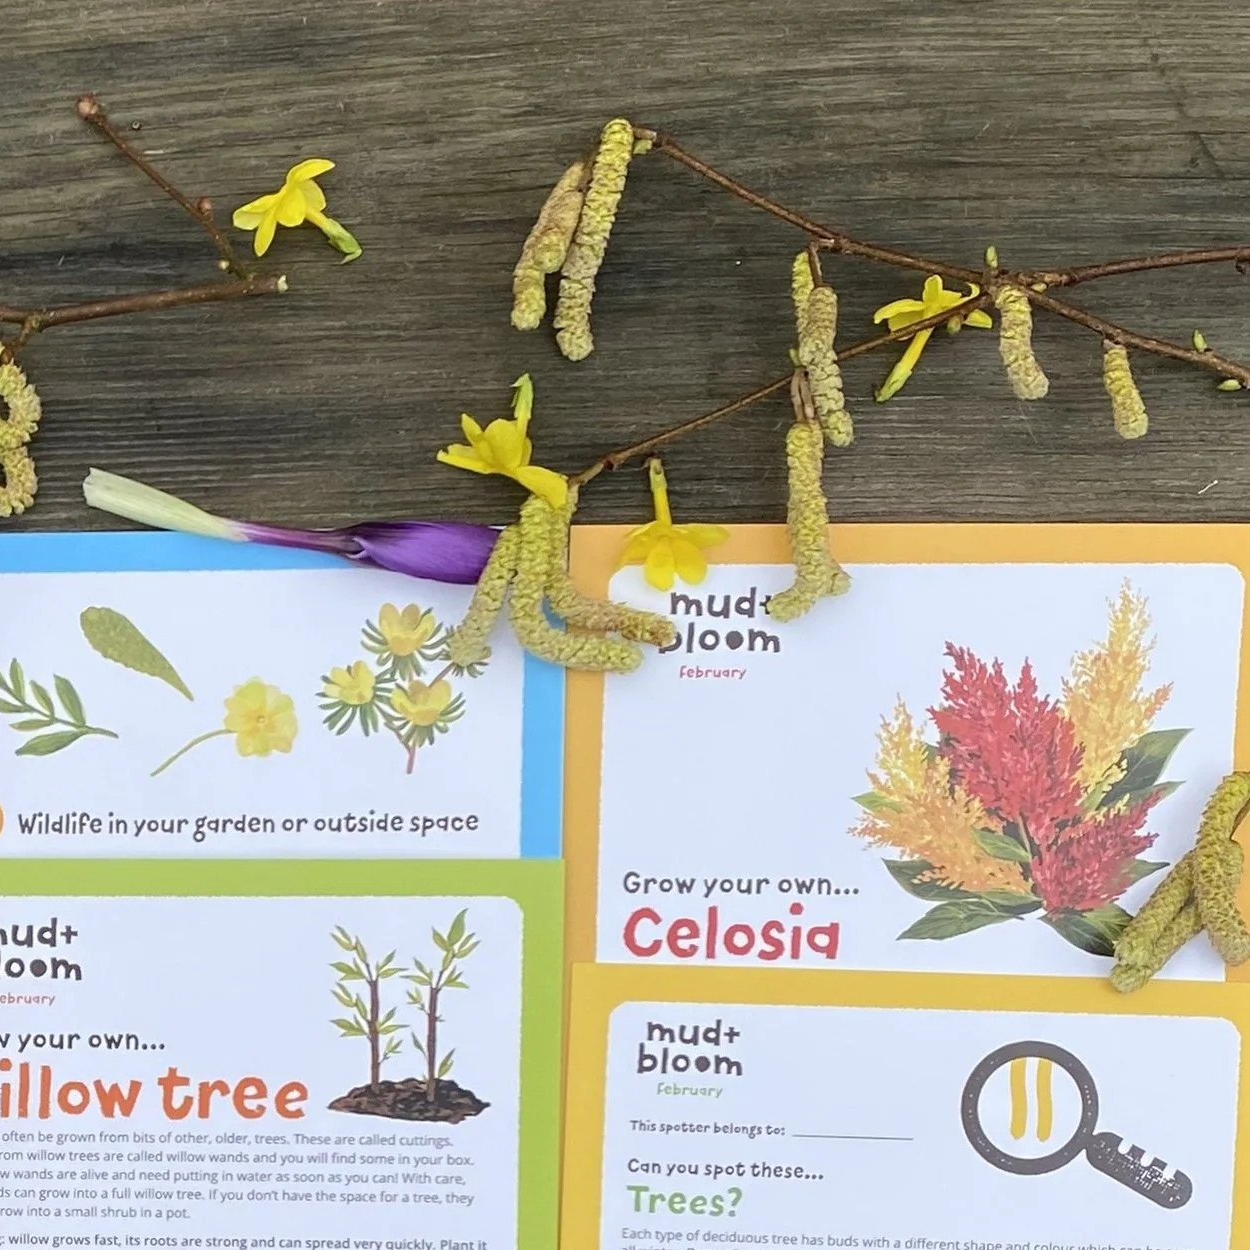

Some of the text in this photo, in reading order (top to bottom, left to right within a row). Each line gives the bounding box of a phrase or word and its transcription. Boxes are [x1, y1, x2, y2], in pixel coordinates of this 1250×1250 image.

[18, 809, 478, 842] Wildlife in your garden or outside space
[623, 871, 858, 903] Grow your own...
[622, 903, 839, 967] Celosia
[18, 1033, 80, 1052] your
[88, 1033, 164, 1050] own...
[647, 1019, 740, 1048] mud+
[637, 1043, 742, 1076] bloom
[157, 1066, 308, 1120] tree
[2, 1130, 34, 1142] often
[38, 1131, 53, 1142] be
[56, 1133, 95, 1145] grown
[99, 1131, 128, 1142] from
[133, 1132, 155, 1143] bits
[158, 1131, 172, 1143] of
[174, 1132, 211, 1144] other,
[215, 1132, 251, 1145] older,
[254, 1134, 289, 1144] trees.
[293, 1133, 331, 1145] These
[334, 1136, 355, 1145] are
[358, 1134, 395, 1145] called
[399, 1135, 453, 1149] cuttings.
[629, 1119, 784, 1139] This spotter belongs to:
[627, 1158, 823, 1179] Can you spot these...
[626, 1185, 742, 1217] Trees?
[8, 1233, 49, 1244] willow
[52, 1236, 90, 1248] grows
[94, 1233, 121, 1246] fast,
[125, 1235, 140, 1245] its
[144, 1236, 177, 1246] roots
[181, 1238, 201, 1246] are
[206, 1237, 247, 1250] strong
[250, 1236, 275, 1247] and
[279, 1239, 301, 1248] can
[305, 1238, 350, 1250] spread
[440, 1239, 474, 1250] Plant
[478, 1240, 487, 1250] it
